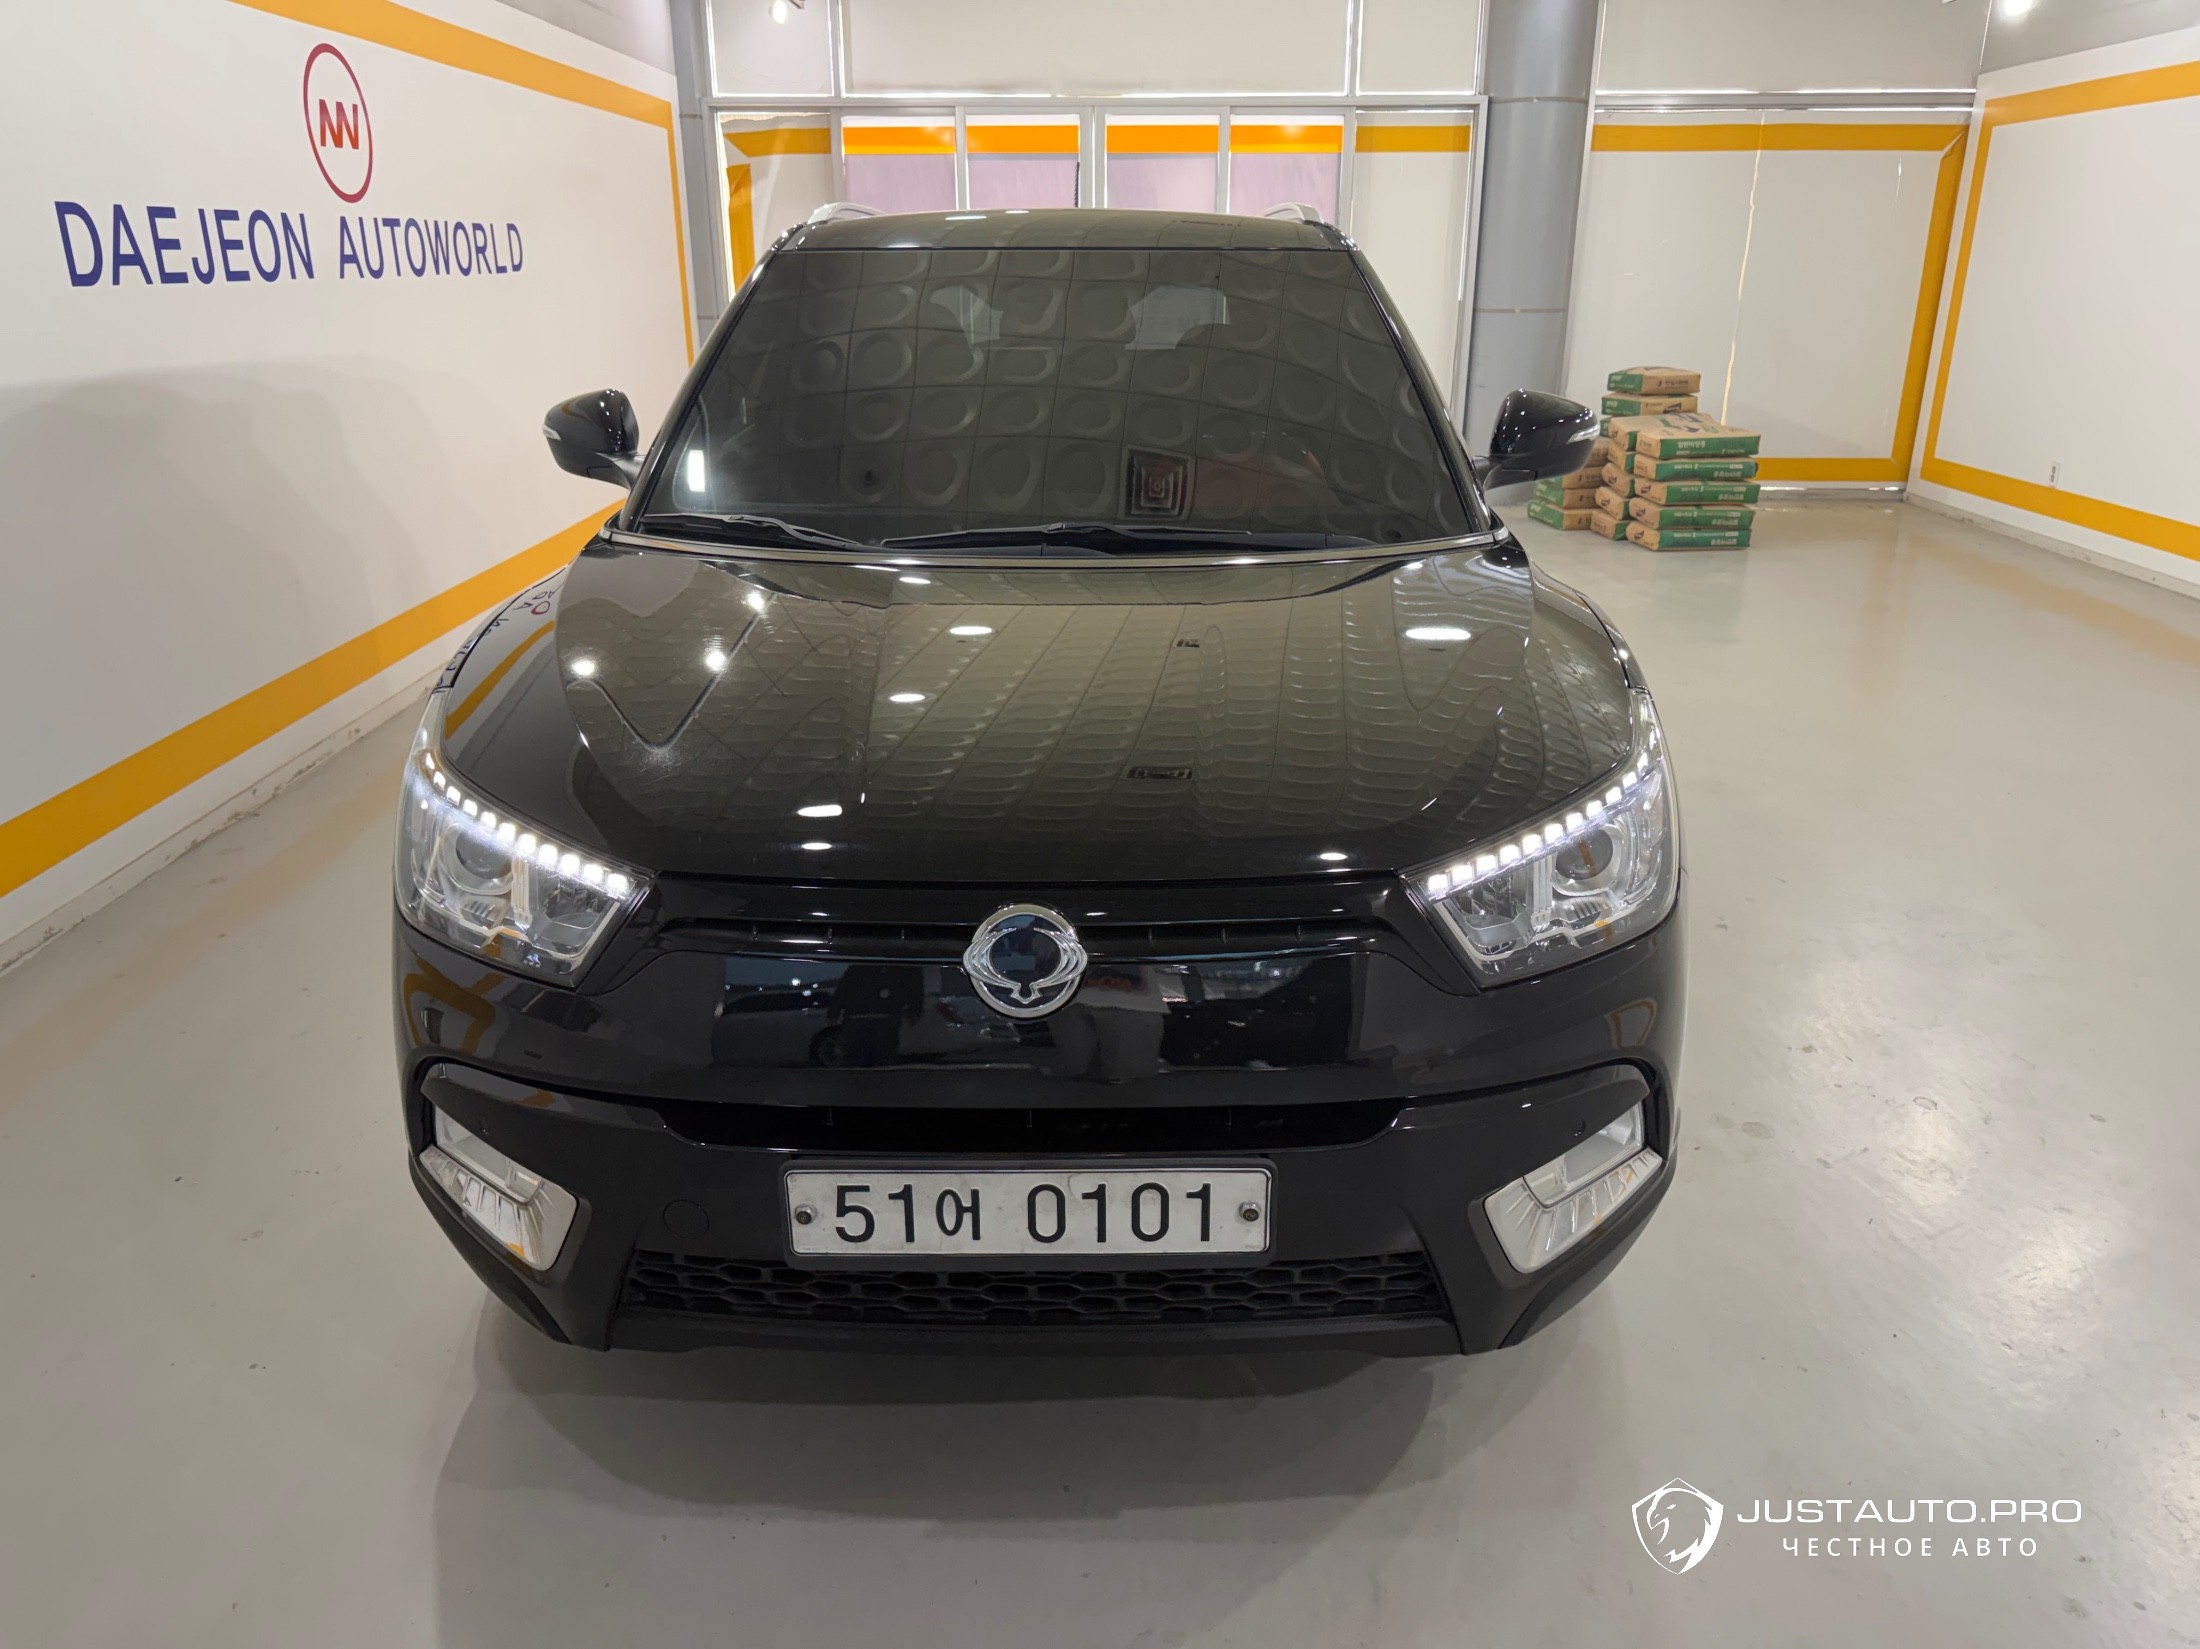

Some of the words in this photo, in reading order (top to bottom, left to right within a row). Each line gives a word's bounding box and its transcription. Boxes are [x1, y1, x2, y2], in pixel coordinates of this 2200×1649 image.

[55, 201, 315, 287] DAEJEON
[339, 215, 524, 280] AUTOWORLD
[835, 1184, 981, 1243] 51어
[1027, 1182, 1211, 1243] 0101
